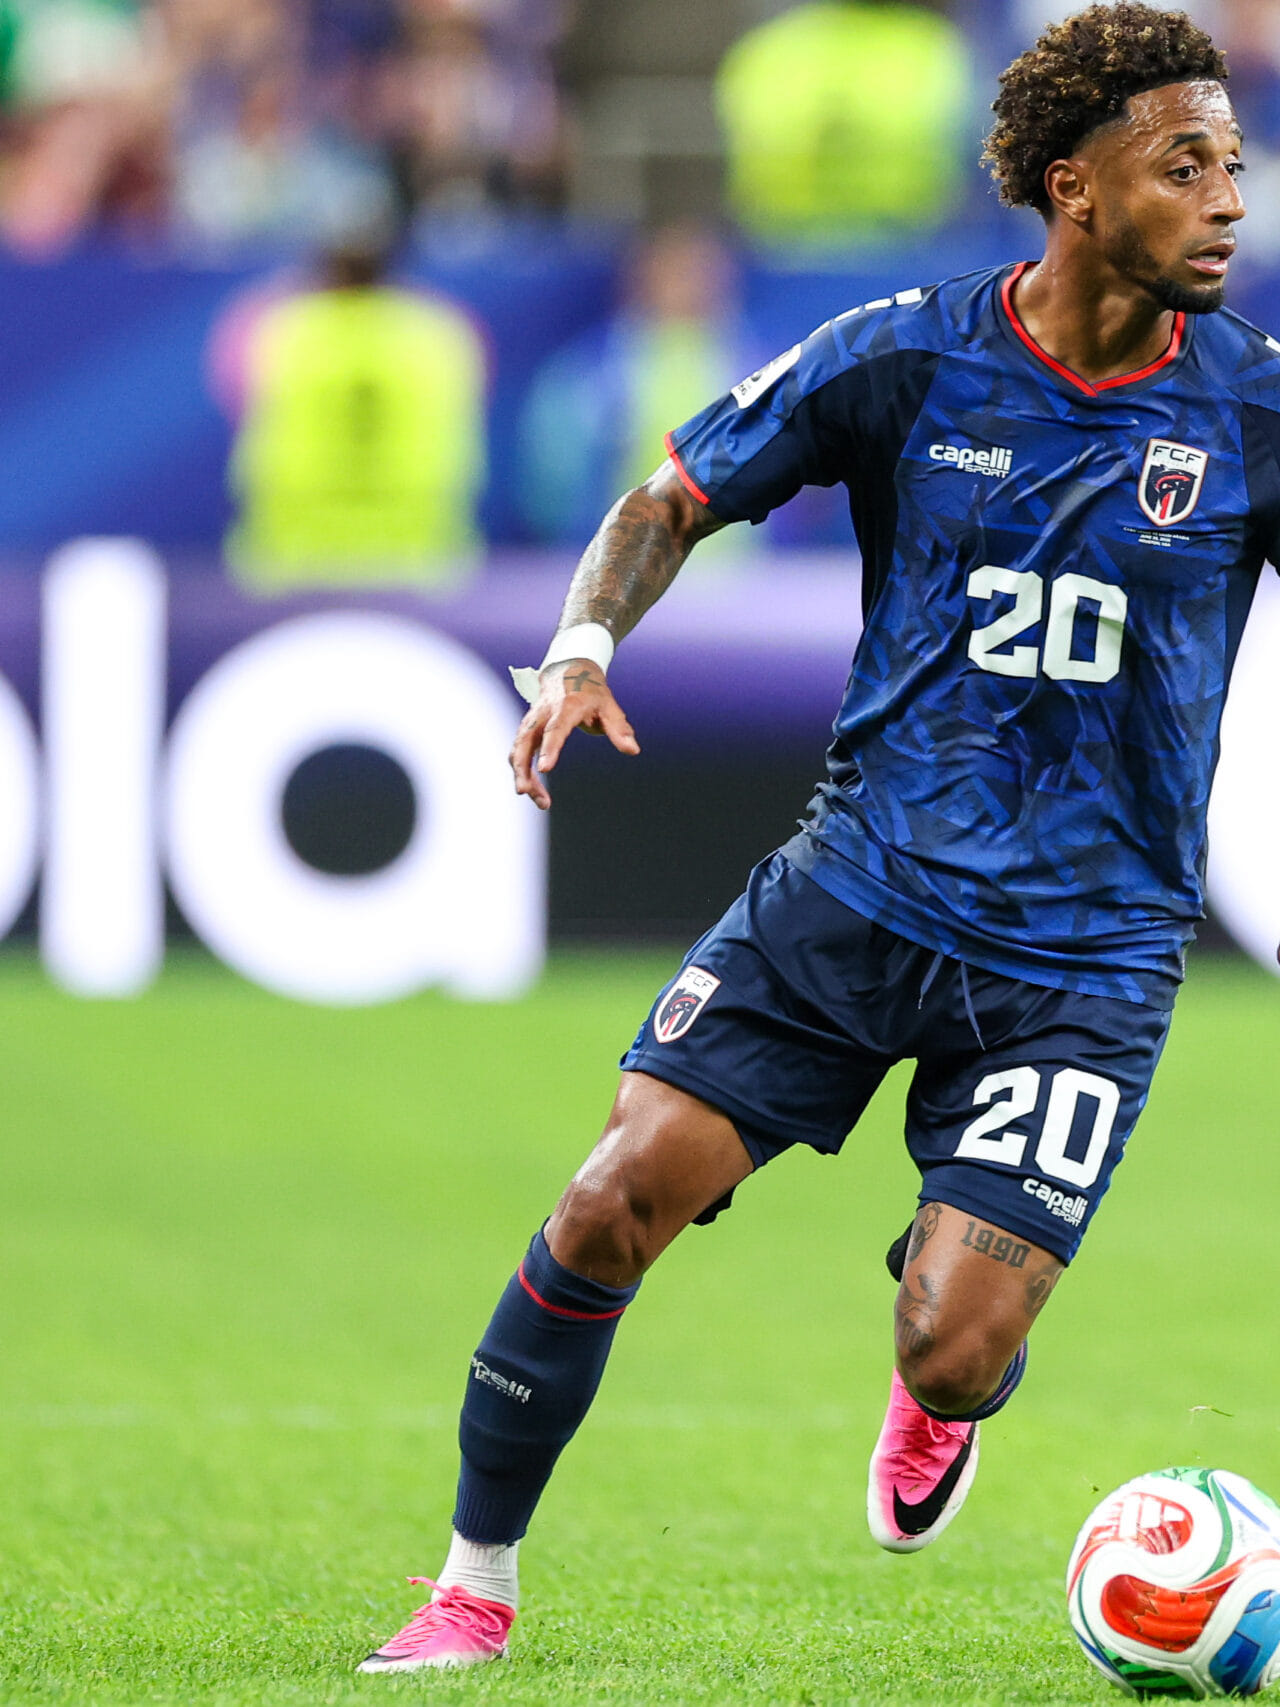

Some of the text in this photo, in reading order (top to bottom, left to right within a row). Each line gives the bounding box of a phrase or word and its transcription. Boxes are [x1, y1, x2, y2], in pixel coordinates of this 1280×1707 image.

[929, 444, 1013, 470] capelli
[964, 464, 1010, 479] SPORT
[1152, 445, 1202, 463] FCF
[966, 564, 1128, 683] 20
[0, 535, 548, 1006] la
[953, 1065, 1121, 1189] 20
[1022, 1178, 1089, 1220] capelli
[1051, 1206, 1081, 1228] SPORT
[961, 1221, 1031, 1268] 1990
